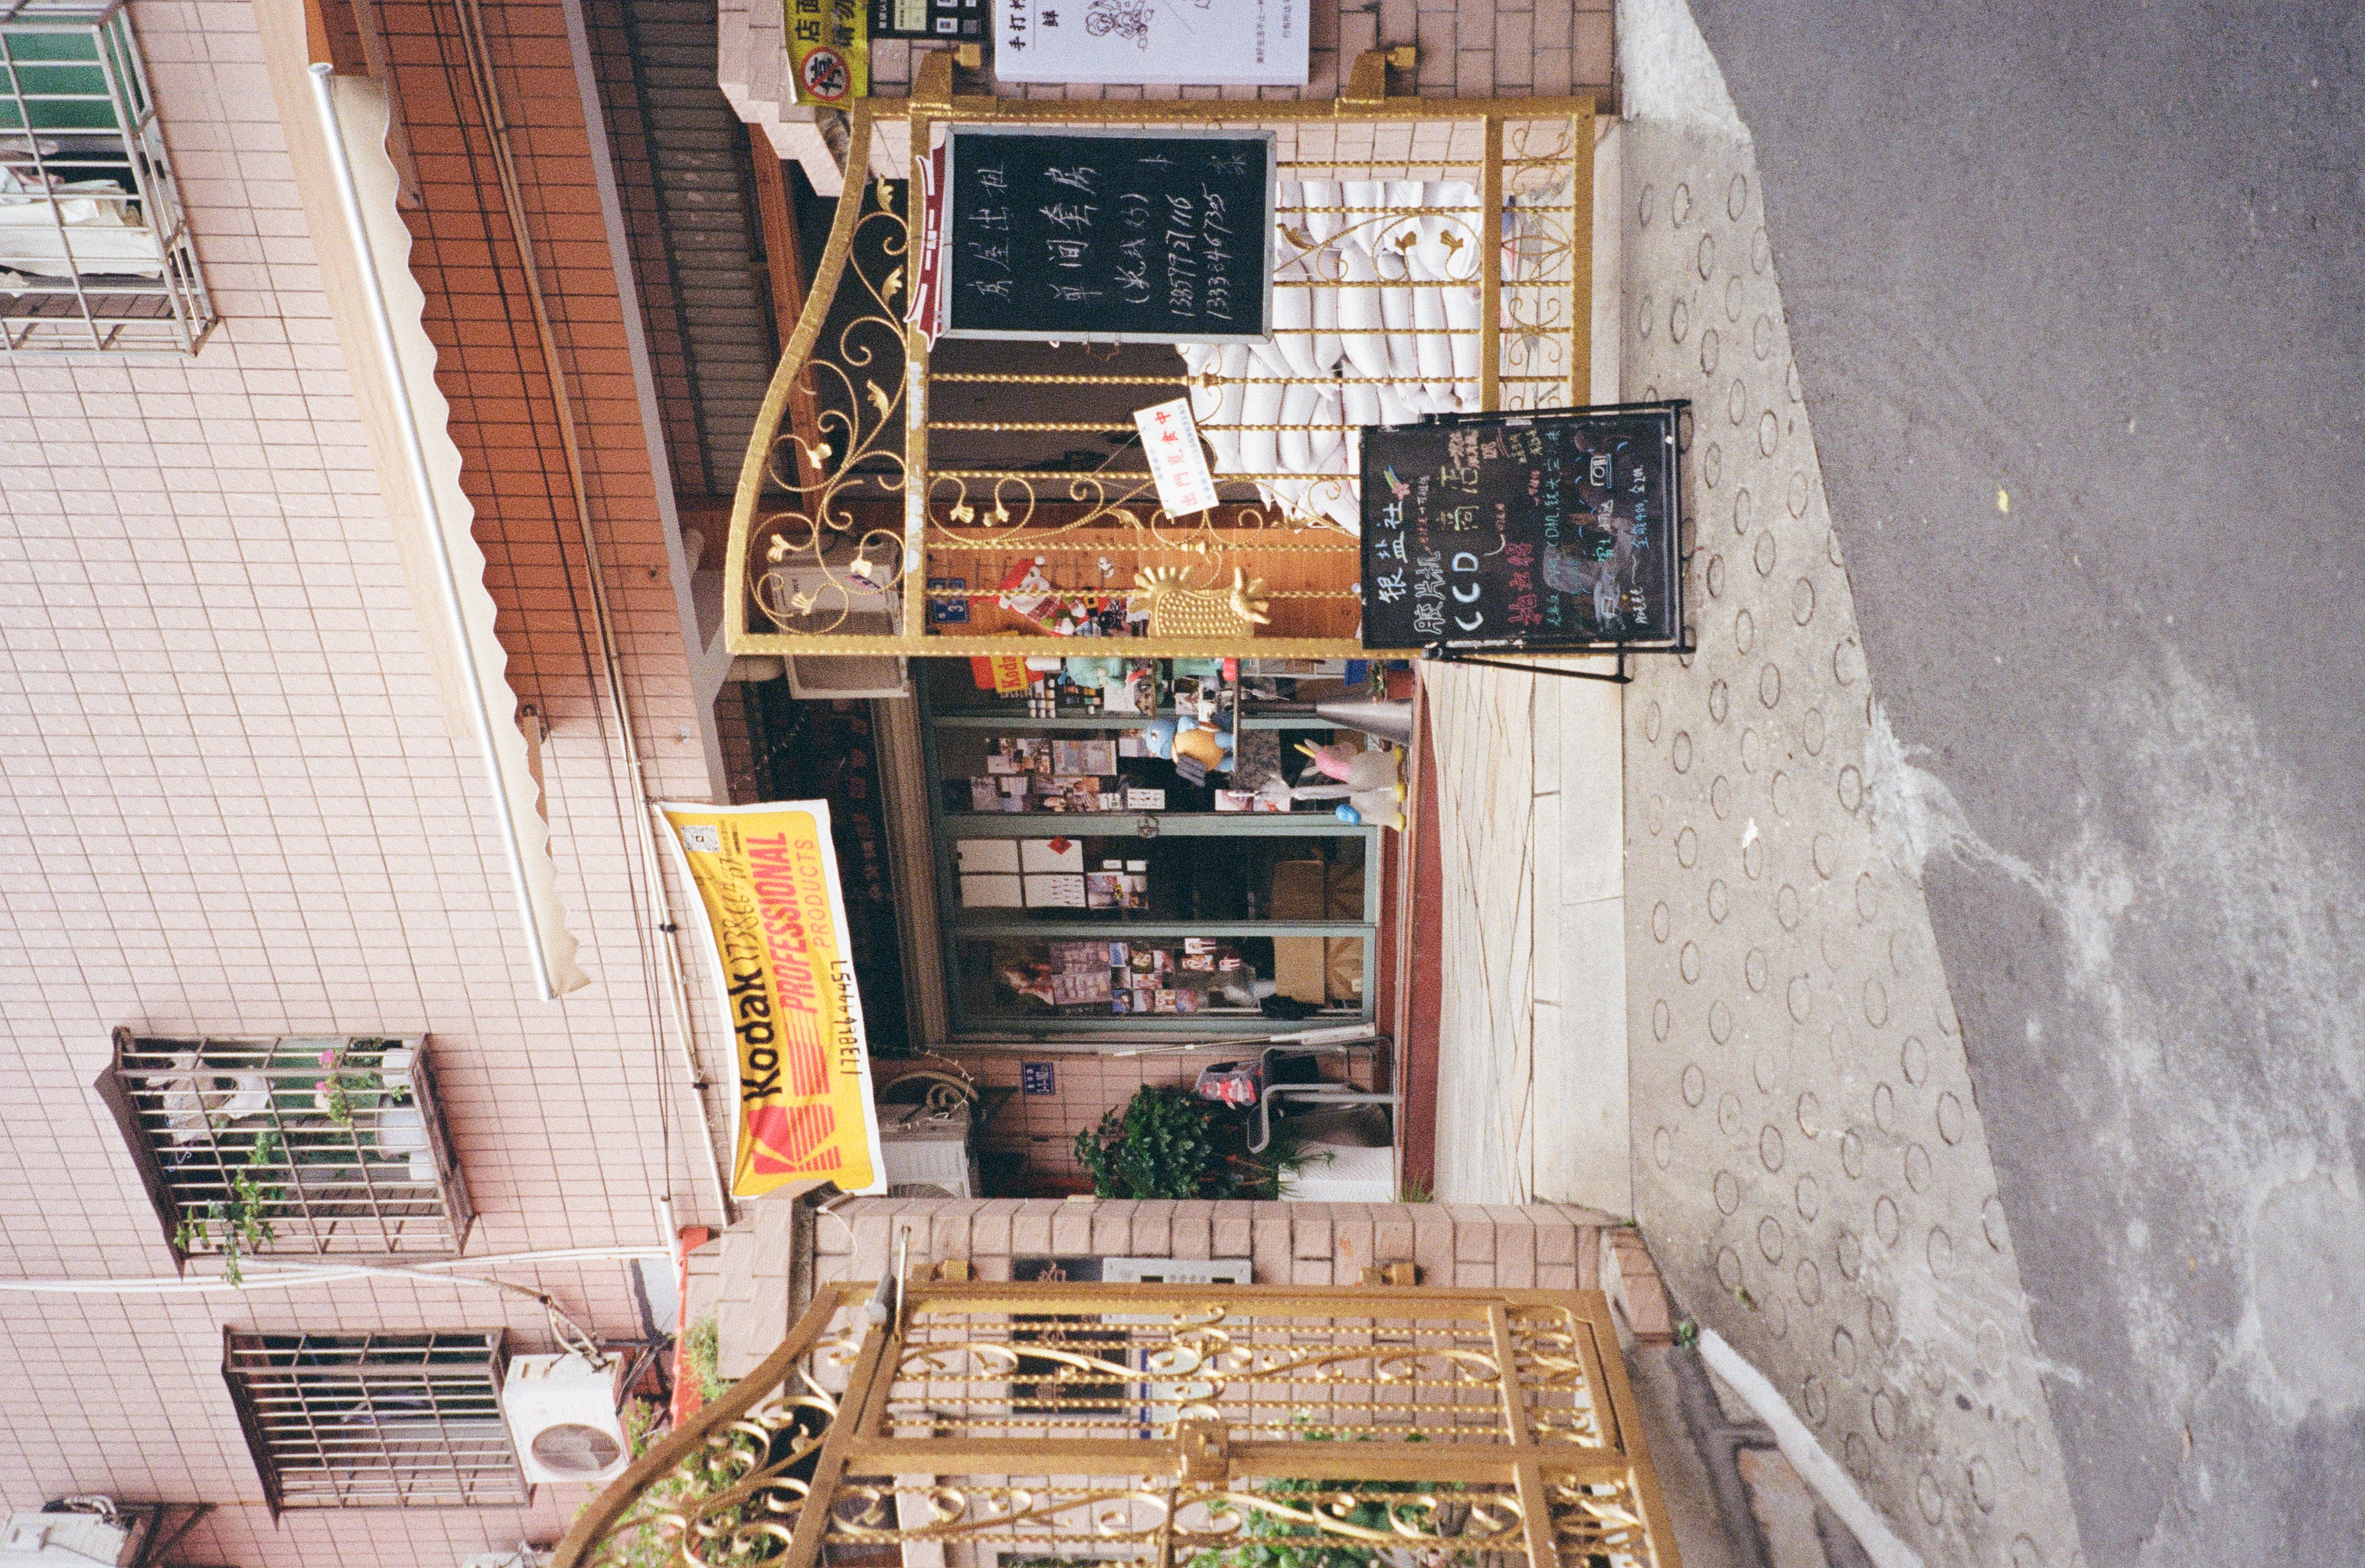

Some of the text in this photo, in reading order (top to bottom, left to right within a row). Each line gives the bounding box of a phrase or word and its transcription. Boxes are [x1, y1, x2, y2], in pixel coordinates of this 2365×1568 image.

[965, 160, 1013, 304] 房屋出租
[1038, 165, 1103, 302] 单间套房
[1377, 499, 1408, 603] 银盐社
[1413, 550, 1446, 635] 胶片机
[1451, 550, 1483, 631] CCD
[998, 656, 1022, 688] Koda
[745, 832, 818, 1014] PROFESSIONAL
[794, 839, 831, 949] PRODUCTS
[727, 968, 782, 1102] Kodak
